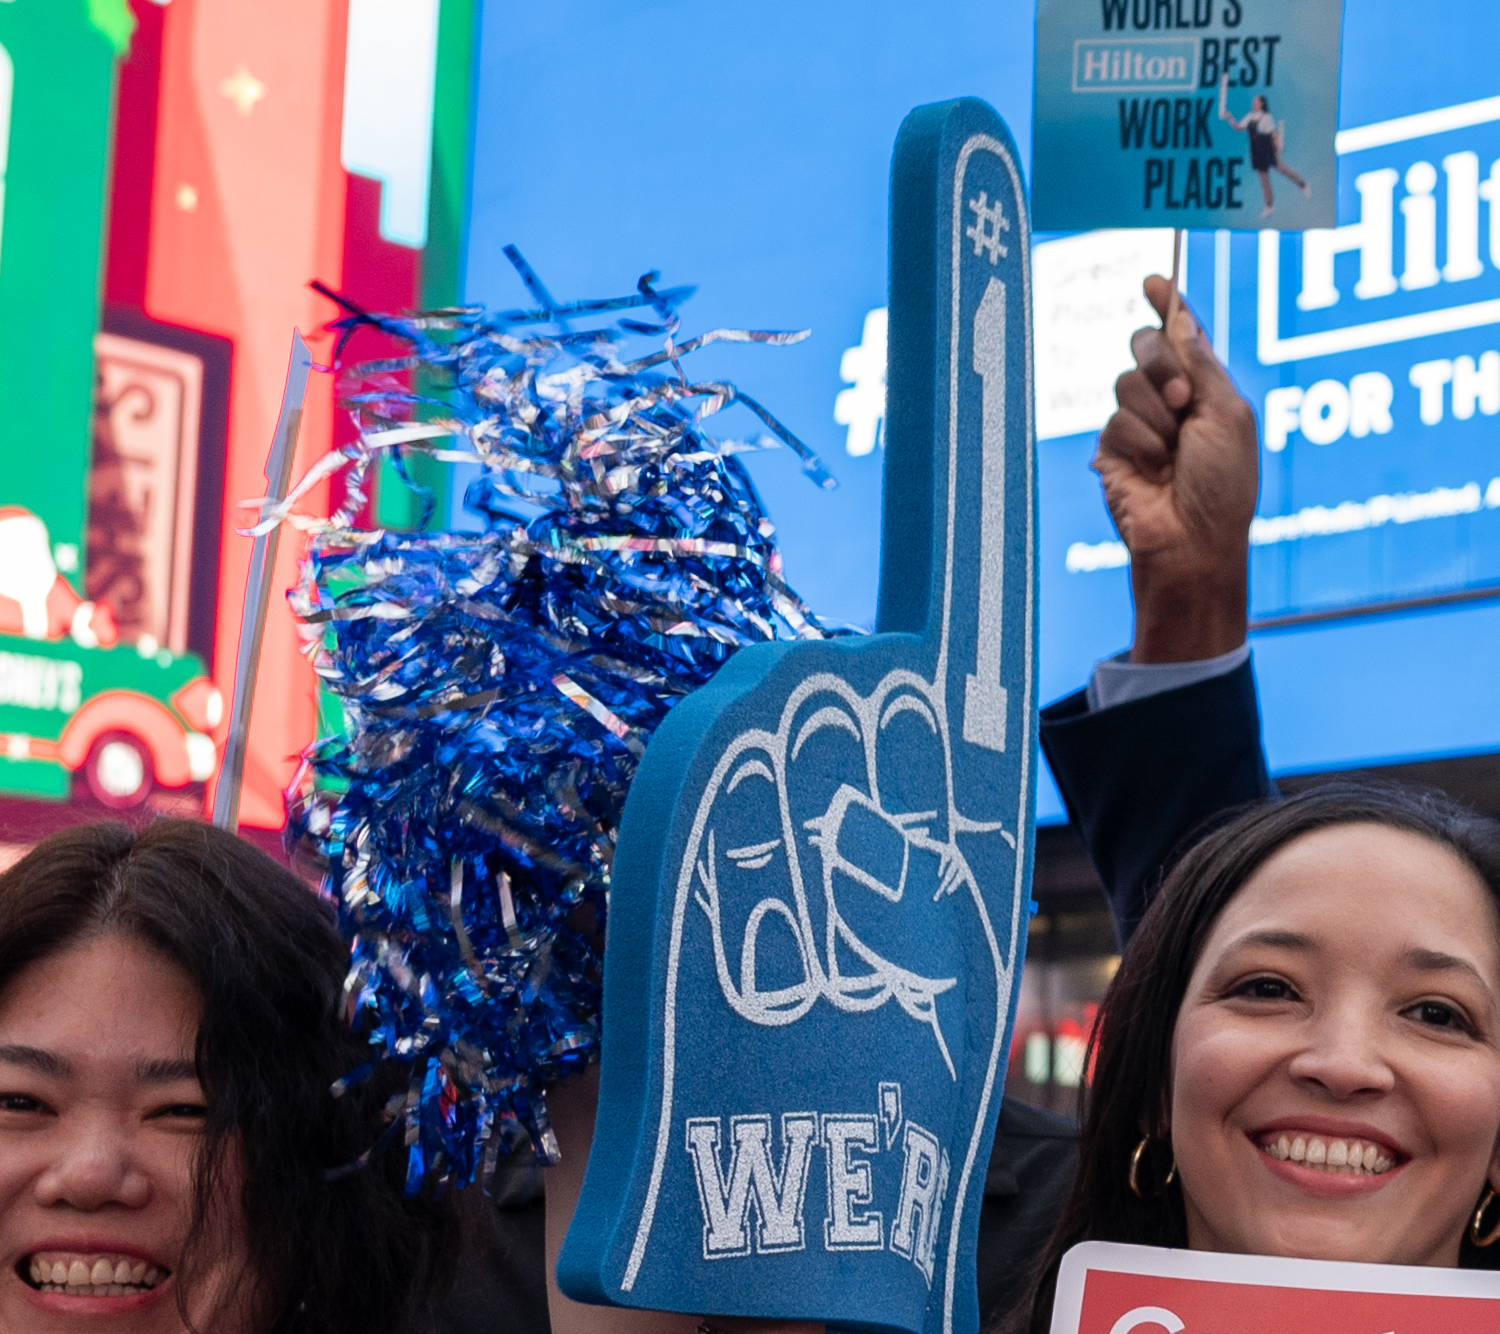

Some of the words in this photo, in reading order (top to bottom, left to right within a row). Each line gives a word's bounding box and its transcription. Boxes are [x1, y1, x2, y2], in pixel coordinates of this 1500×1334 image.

[1082, 49, 1188, 82] Hilton
[1200, 35, 1282, 89] BEST
[1118, 96, 1218, 150] WORK
[1143, 156, 1245, 210] PLACE
[1264, 368, 1395, 452] FOR
[685, 1082, 953, 1291] WE'R
